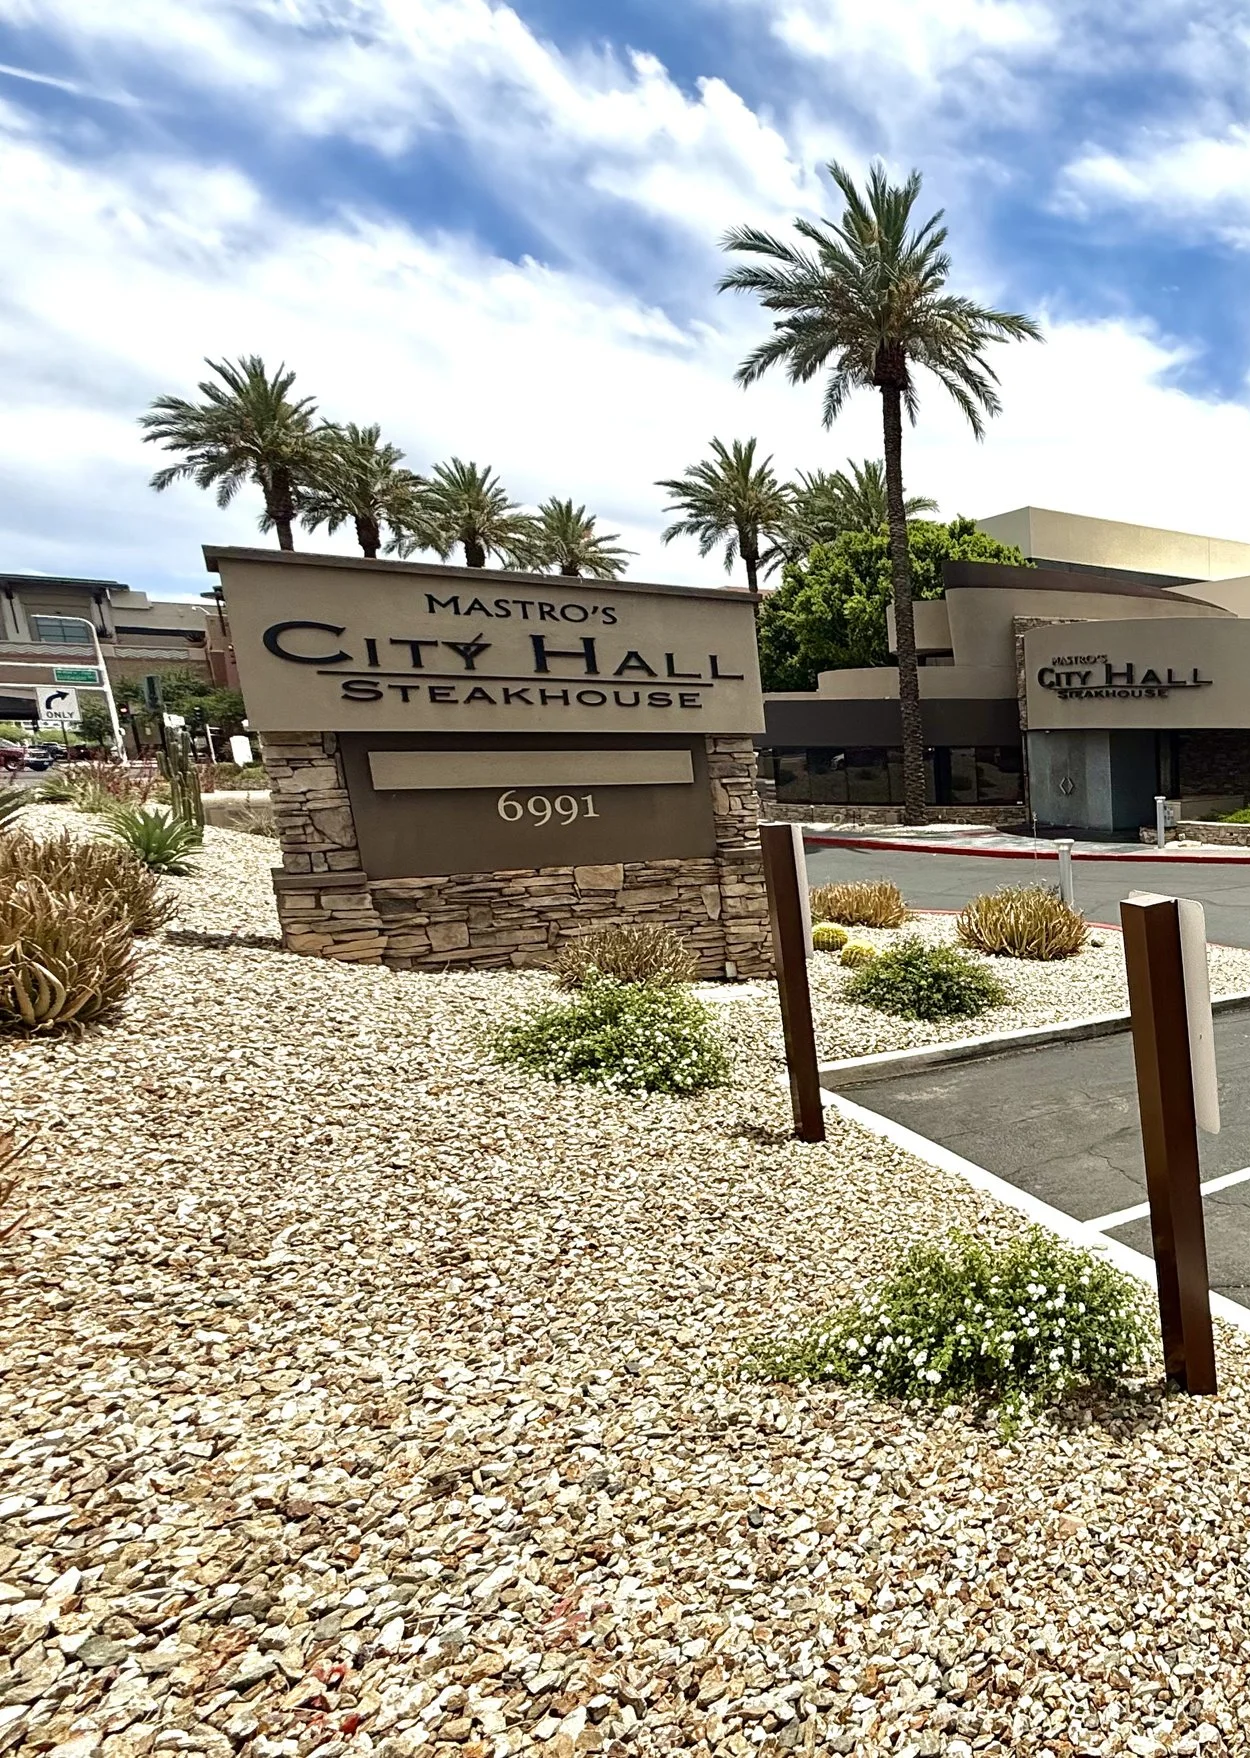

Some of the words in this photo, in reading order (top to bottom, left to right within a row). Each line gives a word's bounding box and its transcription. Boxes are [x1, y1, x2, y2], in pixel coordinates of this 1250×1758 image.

[424, 593, 618, 625] MASTRO'S
[262, 619, 492, 670] CITY
[529, 633, 744, 681] HALL
[1051, 654, 1109, 666] MASTRO'S
[1037, 667, 1092, 689] CITY
[1105, 662, 1213, 685] HALL
[340, 679, 703, 709] STEAKHOUSE
[1057, 688, 1169, 701] STEAKHOUSE
[46, 711, 74, 719] ONLY
[497, 789, 600, 826] 6991
